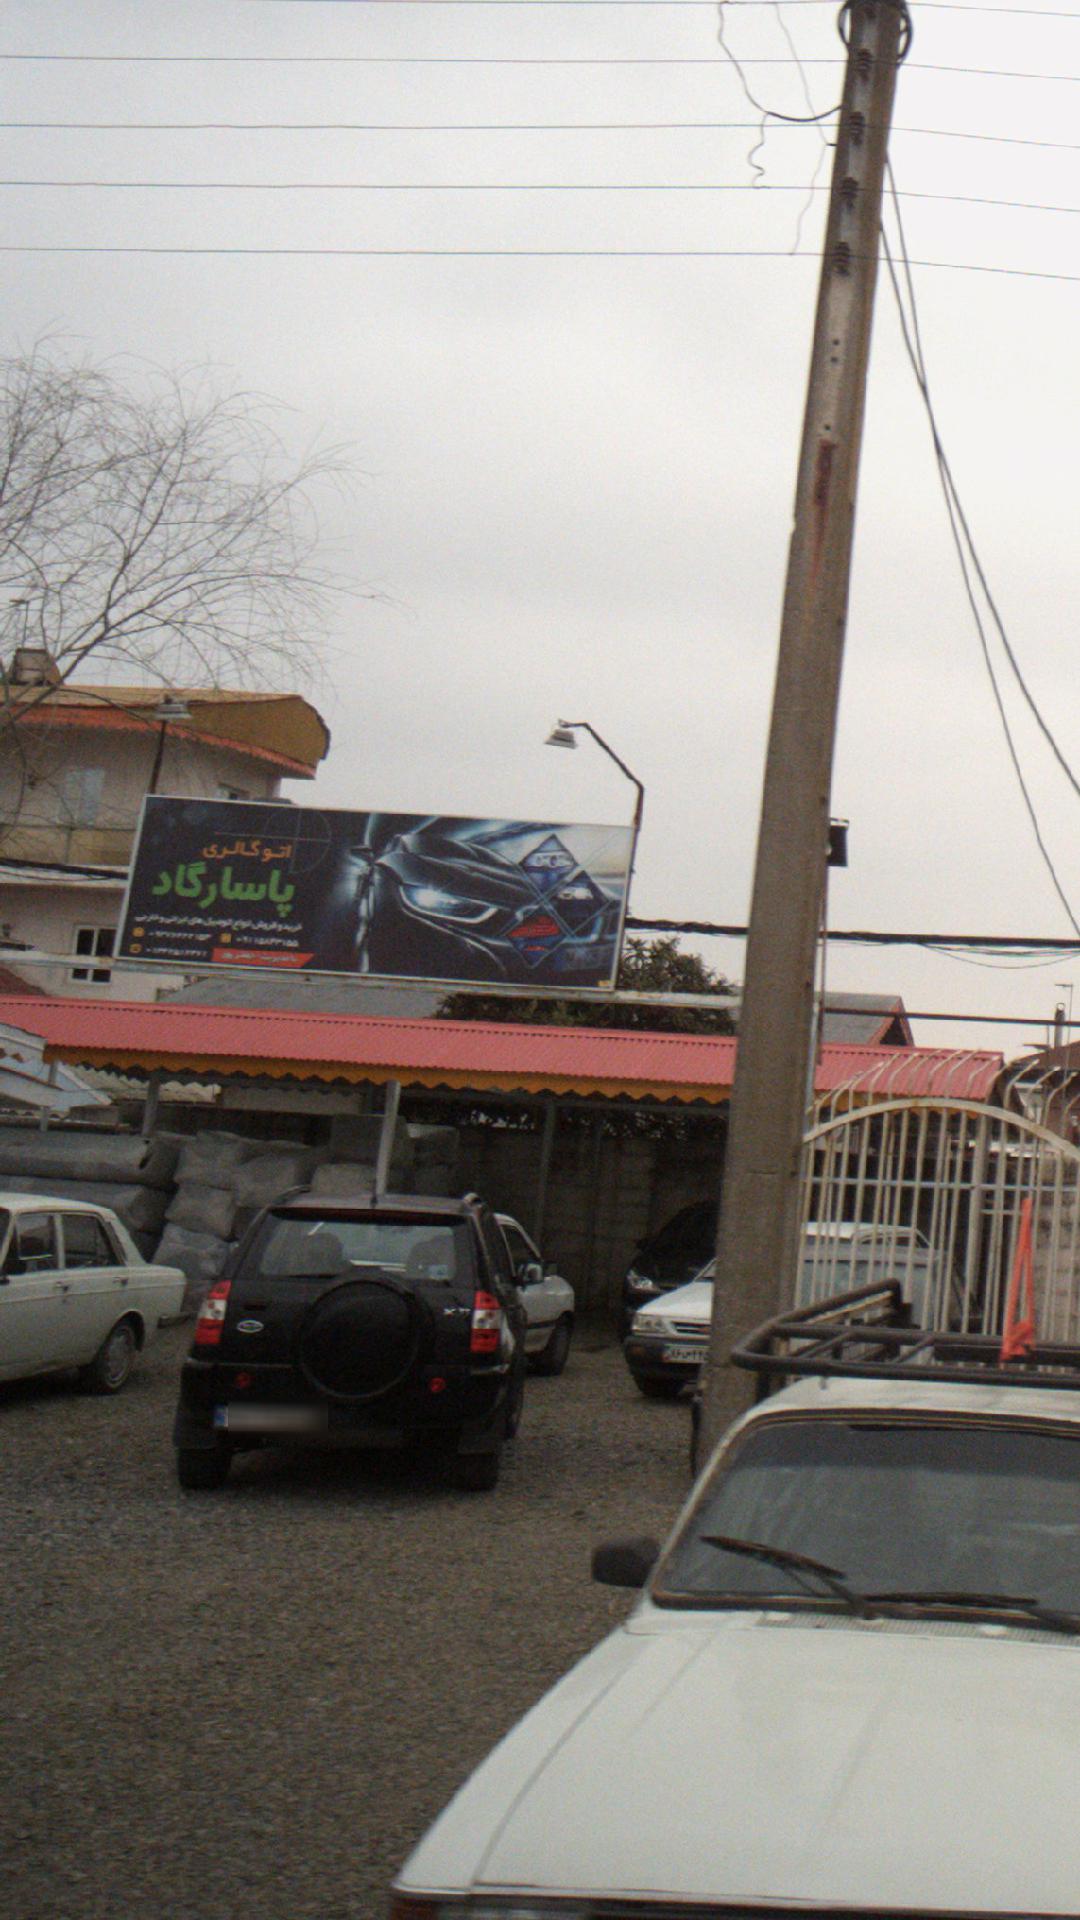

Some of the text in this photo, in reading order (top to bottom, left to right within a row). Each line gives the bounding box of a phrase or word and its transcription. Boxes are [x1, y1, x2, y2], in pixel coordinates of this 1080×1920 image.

[202, 839, 292, 863] اتو گالری
[152, 861, 296, 918] پاسارگاد
